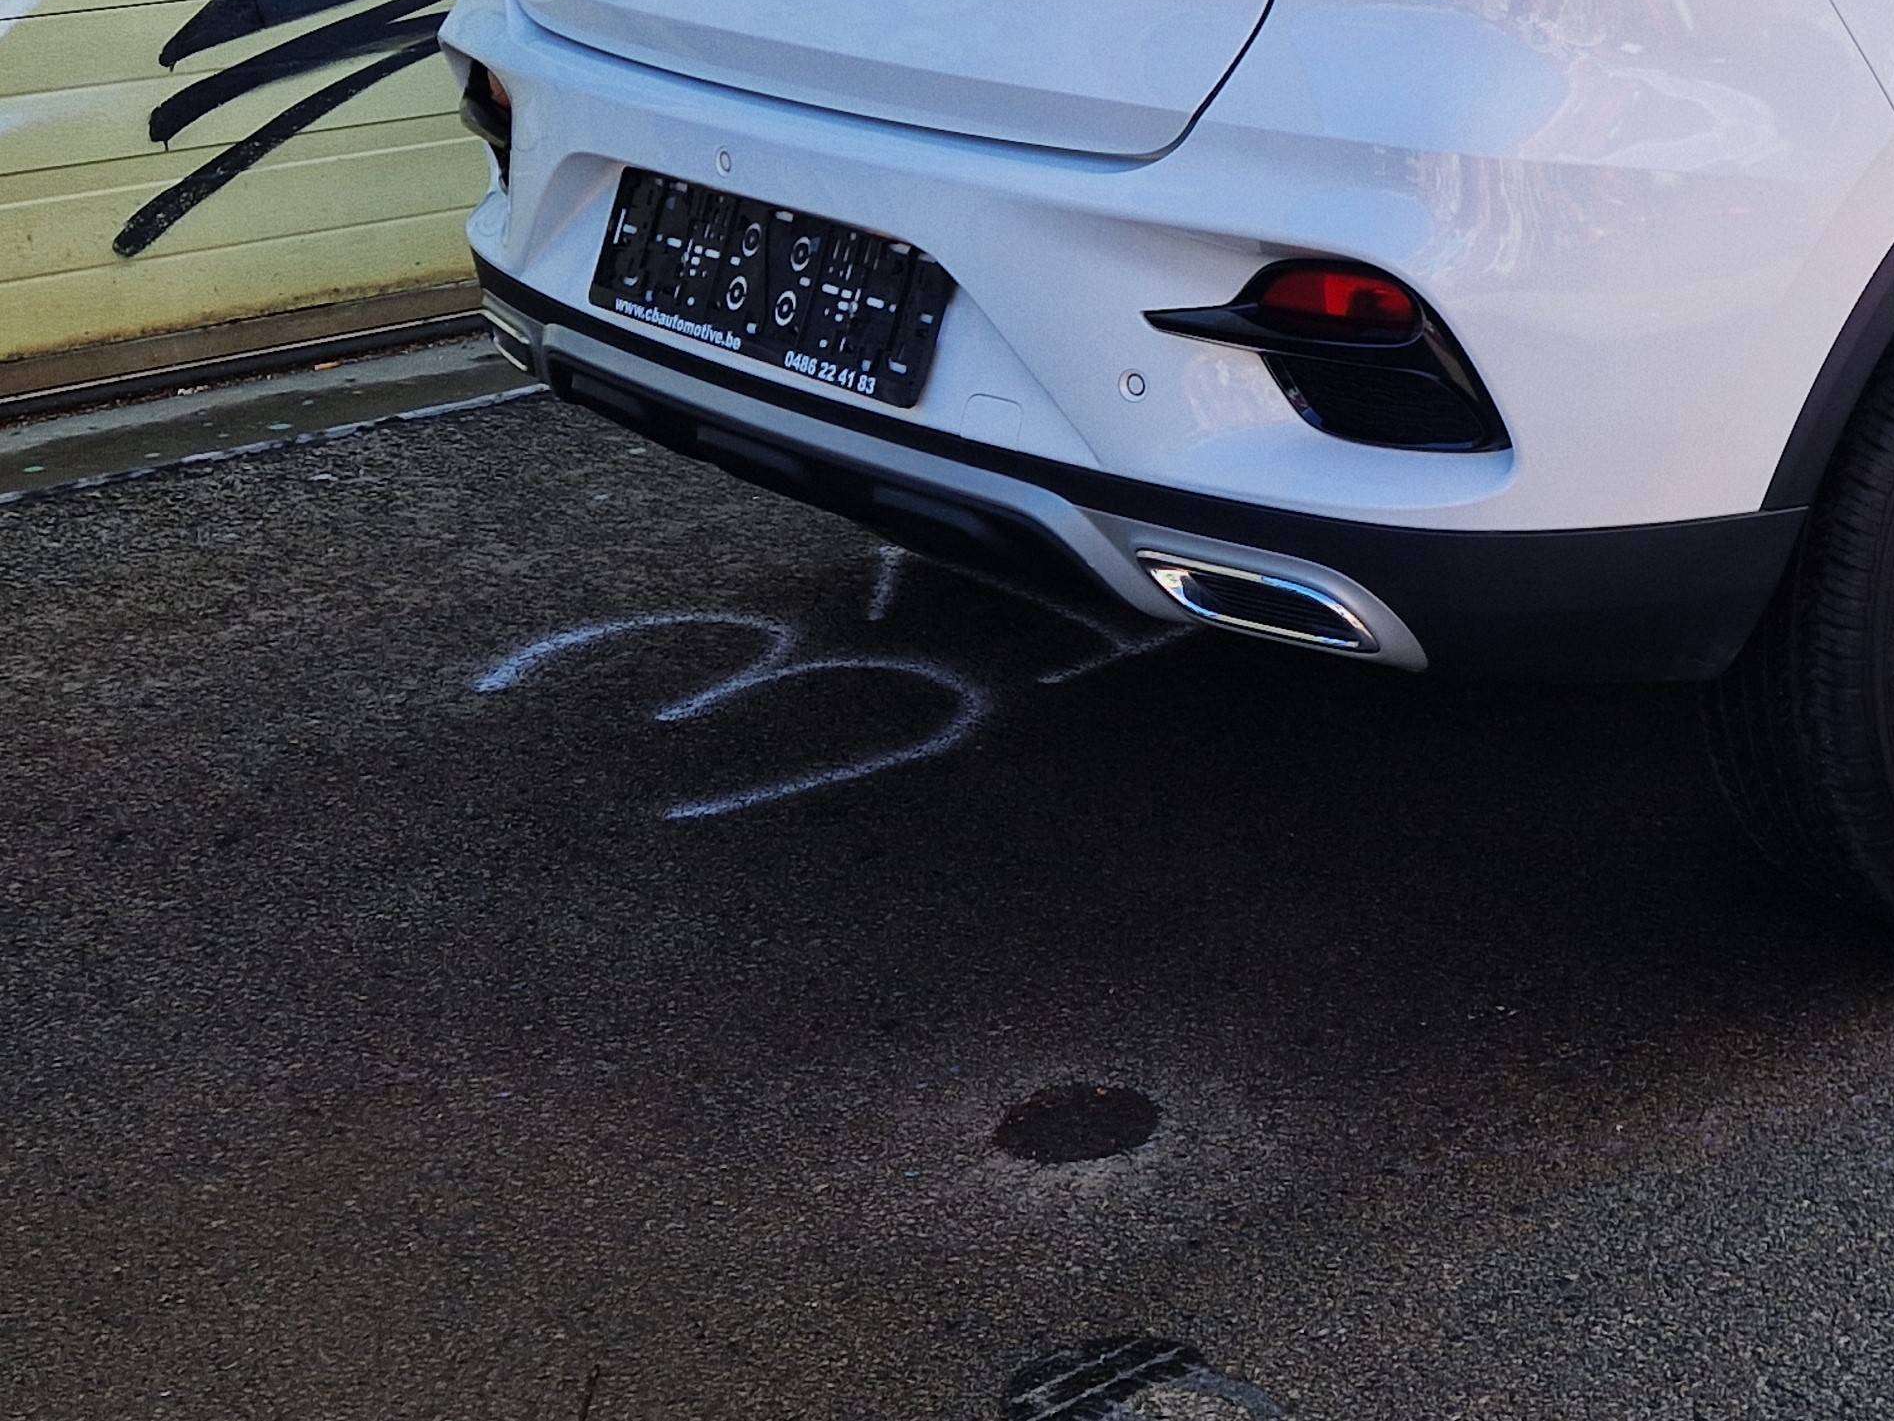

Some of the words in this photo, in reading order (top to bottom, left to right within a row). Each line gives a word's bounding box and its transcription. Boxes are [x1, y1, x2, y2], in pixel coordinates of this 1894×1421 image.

[784, 350, 817, 376] 0486
[818, 361, 837, 382] 22
[838, 368, 856, 389] 41
[857, 374, 876, 395] 83
